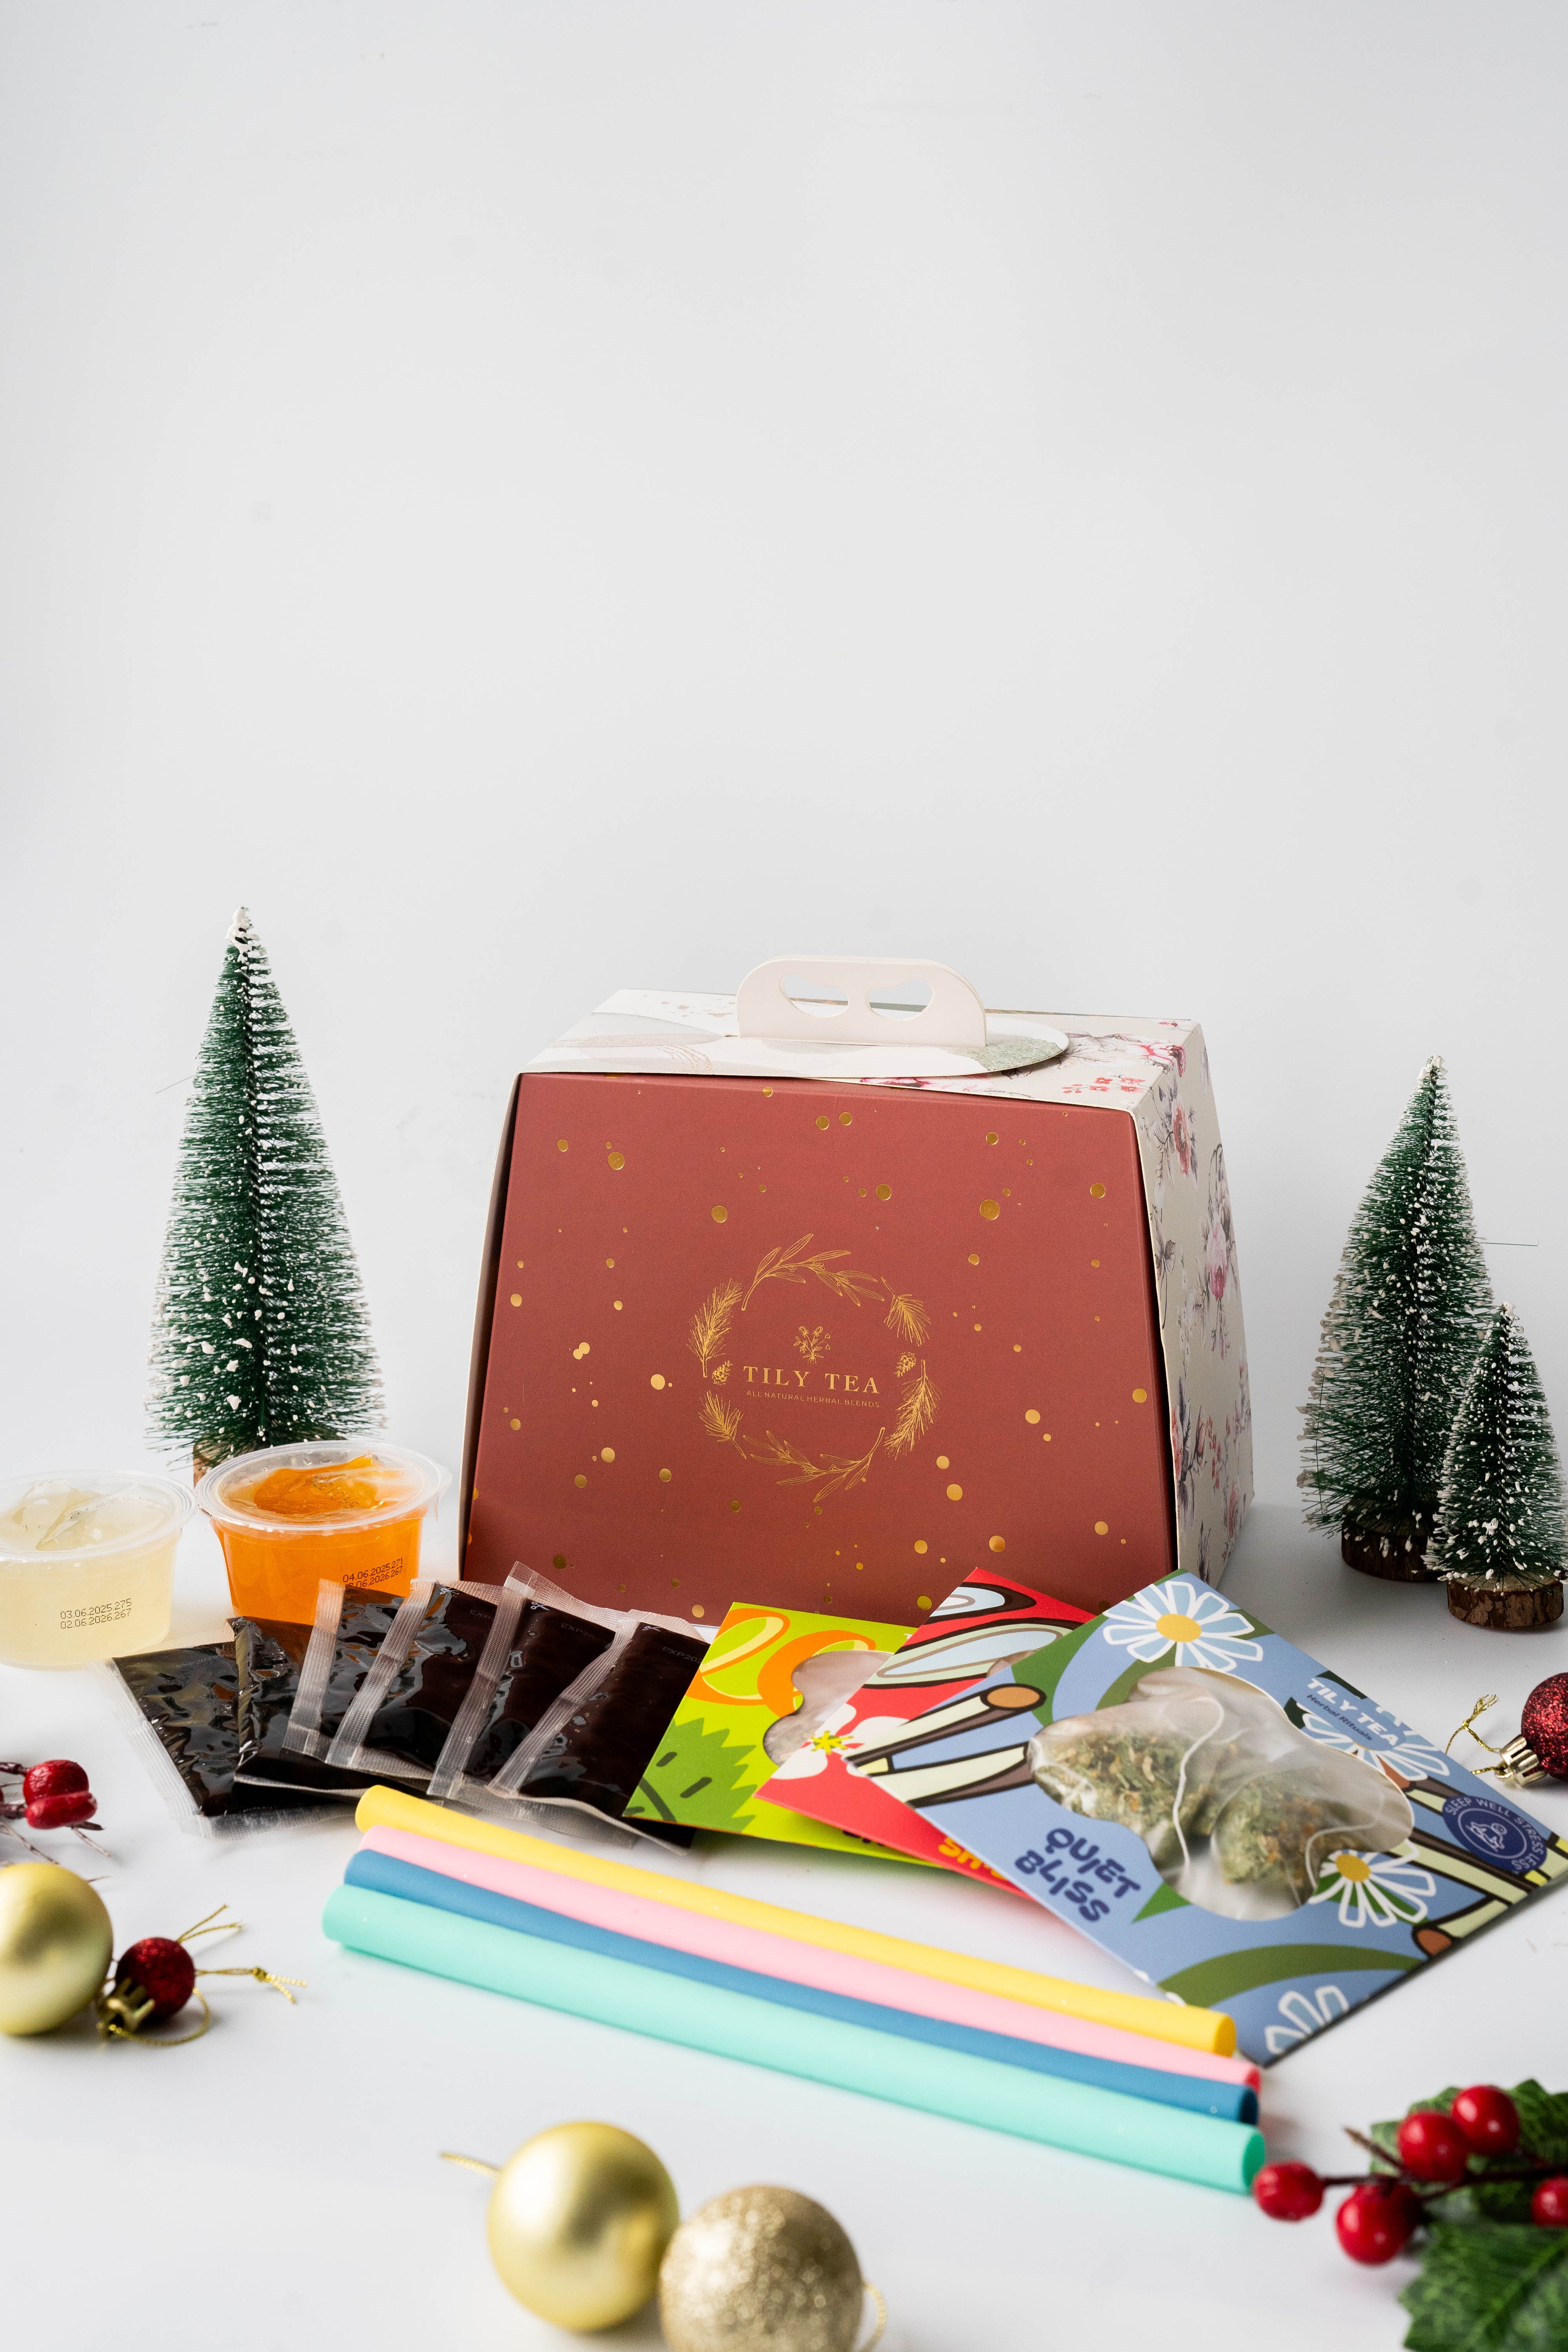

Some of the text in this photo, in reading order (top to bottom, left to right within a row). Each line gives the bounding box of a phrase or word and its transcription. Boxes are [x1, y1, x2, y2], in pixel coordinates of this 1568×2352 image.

[743, 1365, 880, 1394] TILY TEA
[765, 1392, 804, 1401] NATURAL
[807, 1396, 842, 1405] HERBAL
[844, 1399, 880, 1408] BLENDS
[343, 1557, 403, 1583] 04.06.2025.271
[60, 1598, 132, 1619] 03.06.2025.275
[60, 1608, 132, 1629] 02.06.2026.267
[1307, 1678, 1399, 1746] TILY TEA
[1307, 1695, 1372, 1741] Herbal Rituals
[1444, 1797, 1545, 1871] SLEEP WELL STRESS LESS
[1045, 1827, 1141, 1899] QUIET
[1014, 1849, 1111, 1922] BLISS
